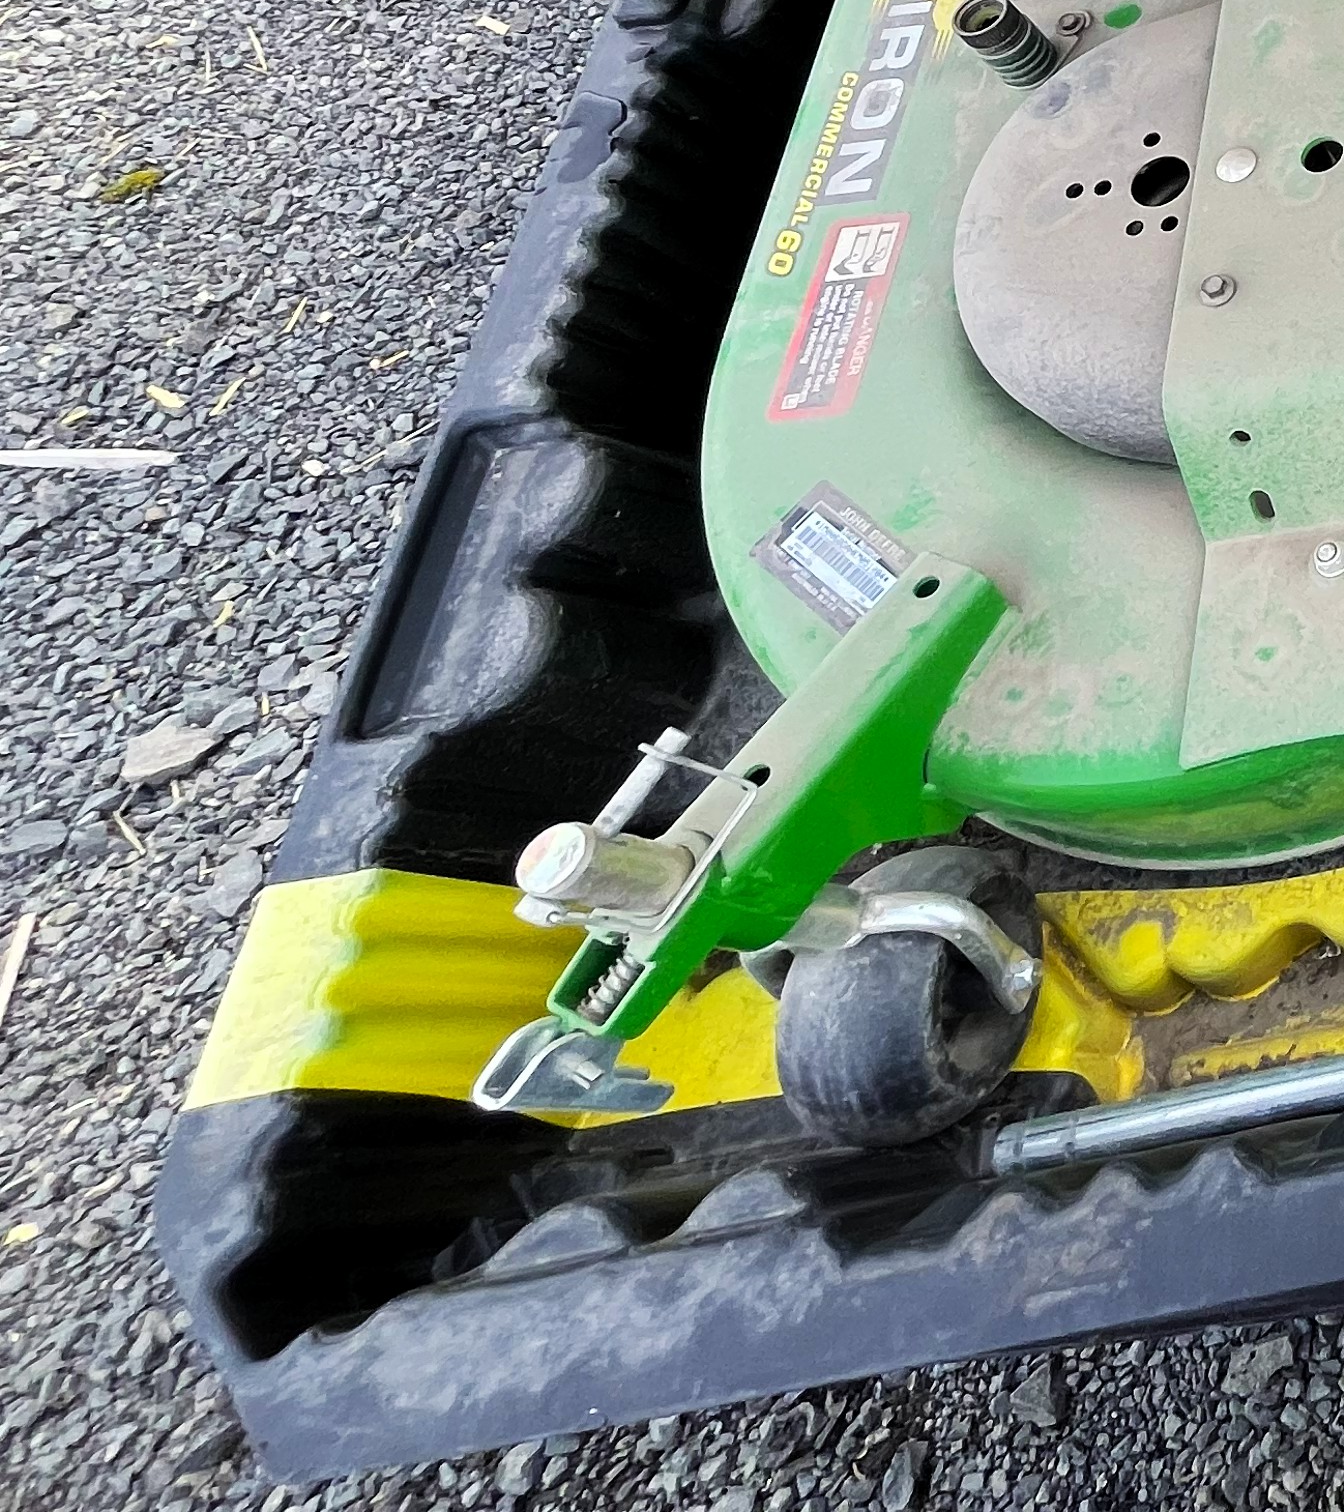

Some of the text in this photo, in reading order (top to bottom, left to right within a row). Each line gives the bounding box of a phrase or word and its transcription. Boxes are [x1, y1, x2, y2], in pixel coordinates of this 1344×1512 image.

[767, 71, 860, 277] COMMERCIAL 60
[840, 507, 872, 533] JOHN
[867, 529, 906, 560] DEERE
